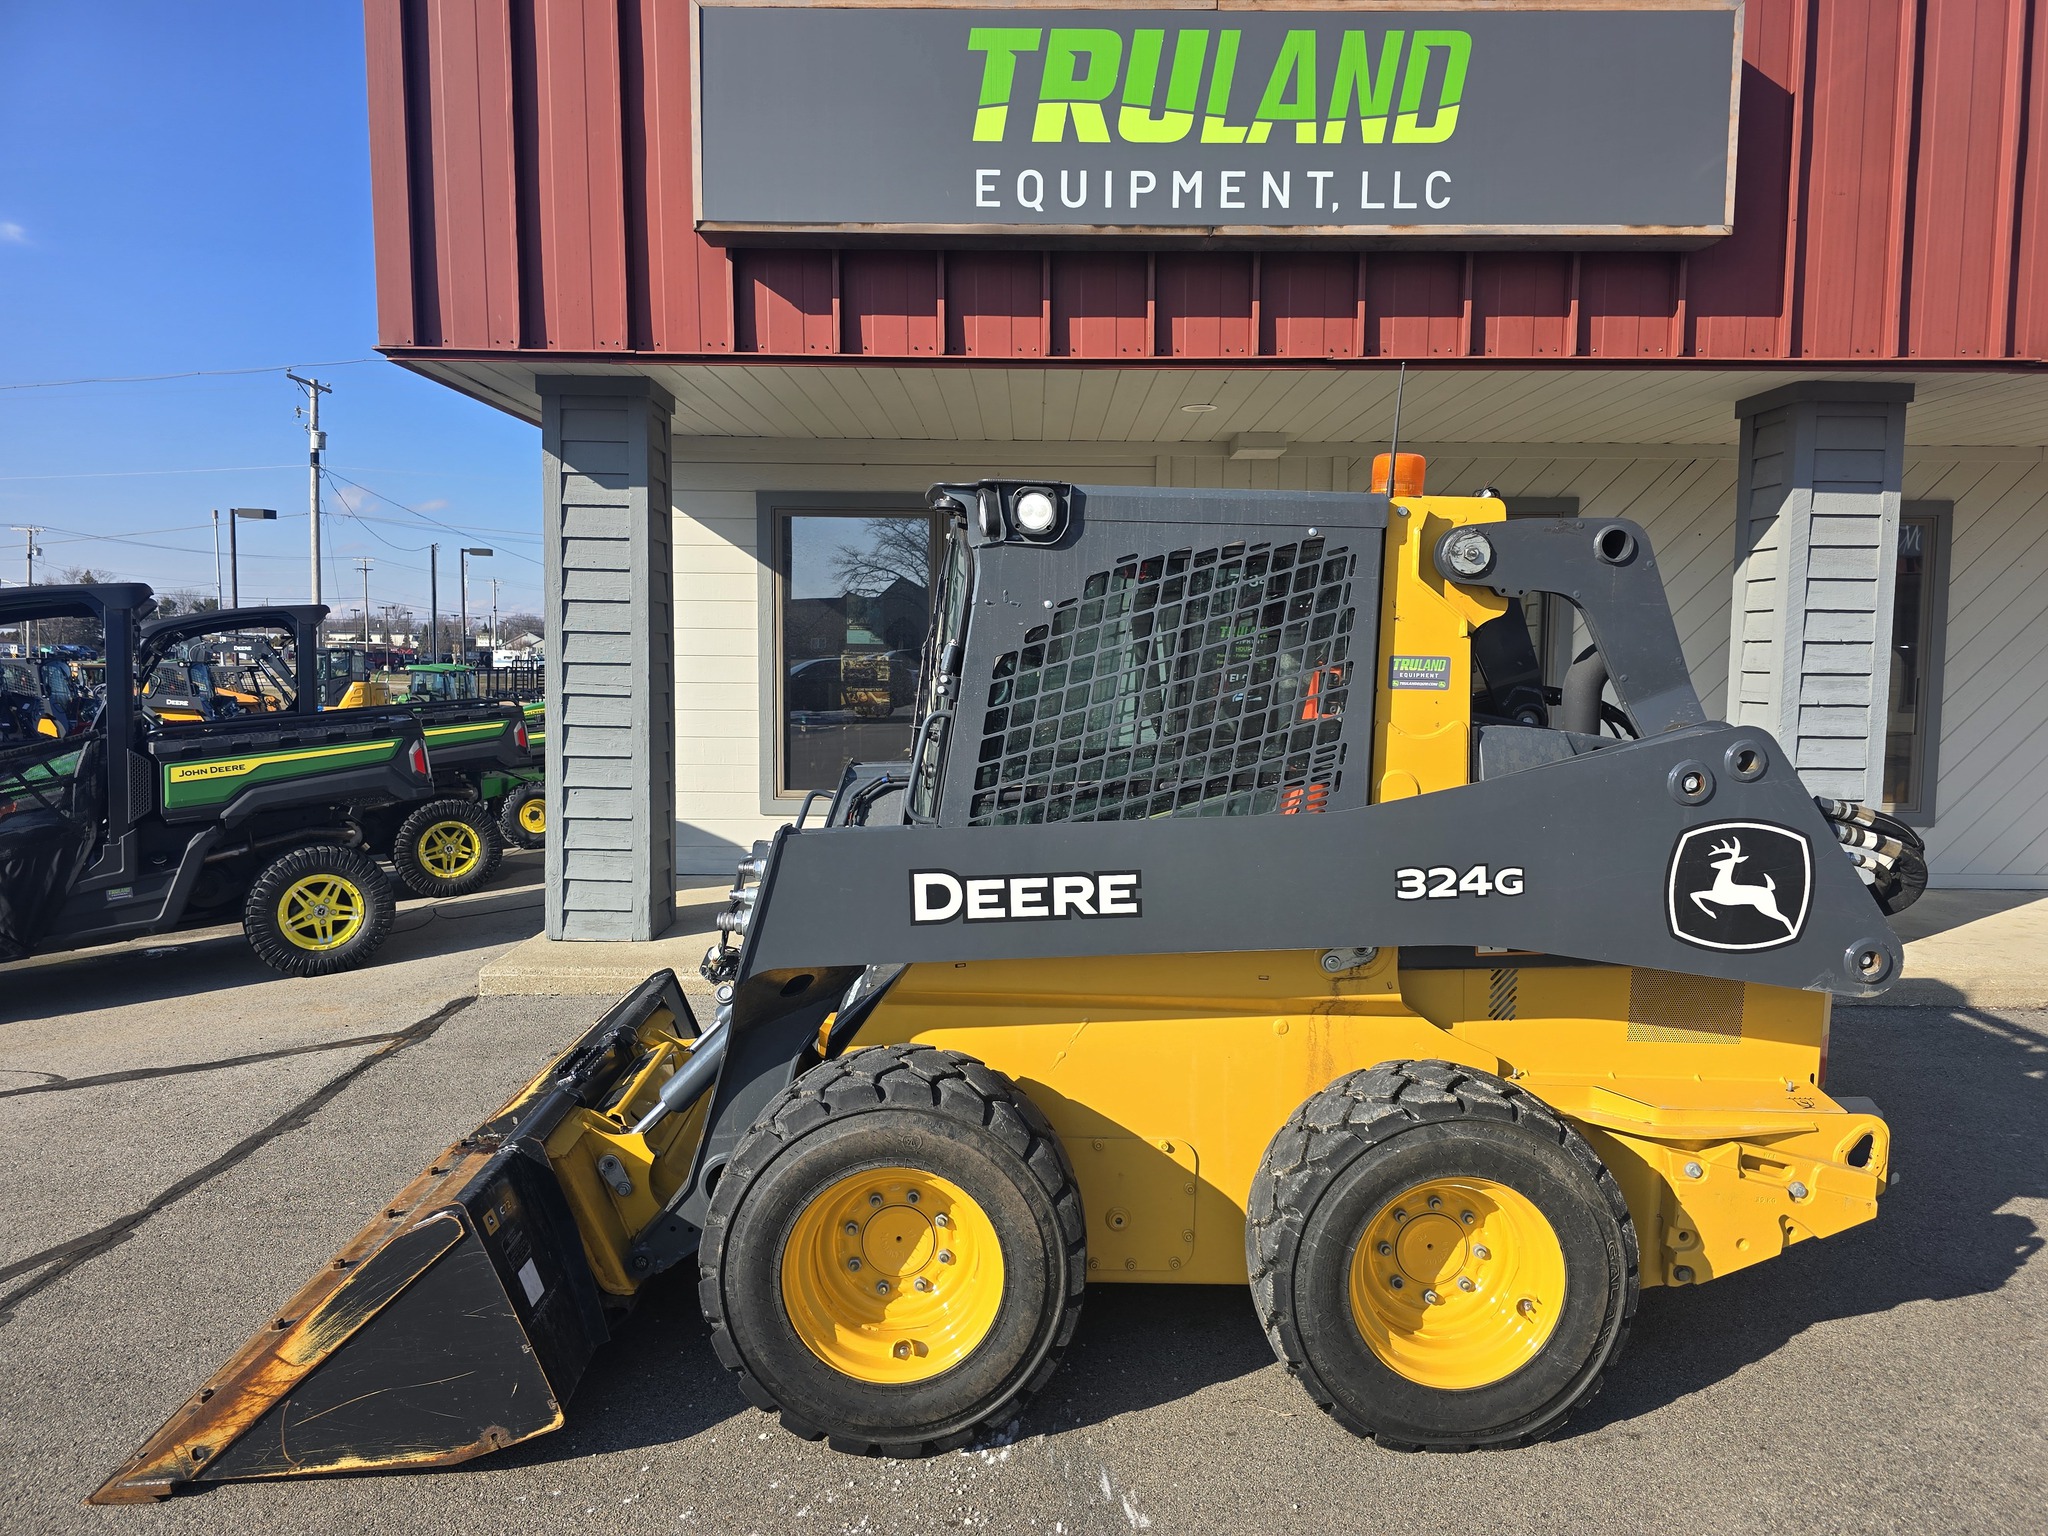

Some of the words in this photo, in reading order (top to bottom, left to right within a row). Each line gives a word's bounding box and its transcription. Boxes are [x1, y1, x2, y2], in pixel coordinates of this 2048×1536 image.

[967, 28, 1473, 144] TRULAND
[975, 168, 1342, 213] EQUIPMENT,
[1360, 169, 1452, 210] LLC
[1393, 658, 1447, 672] TRULAND
[166, 698, 189, 706] DEERE
[178, 768, 208, 778] JOHN
[209, 763, 246, 774] DEERE
[912, 872, 1139, 922] DEERE
[1396, 866, 1524, 900] 324G
